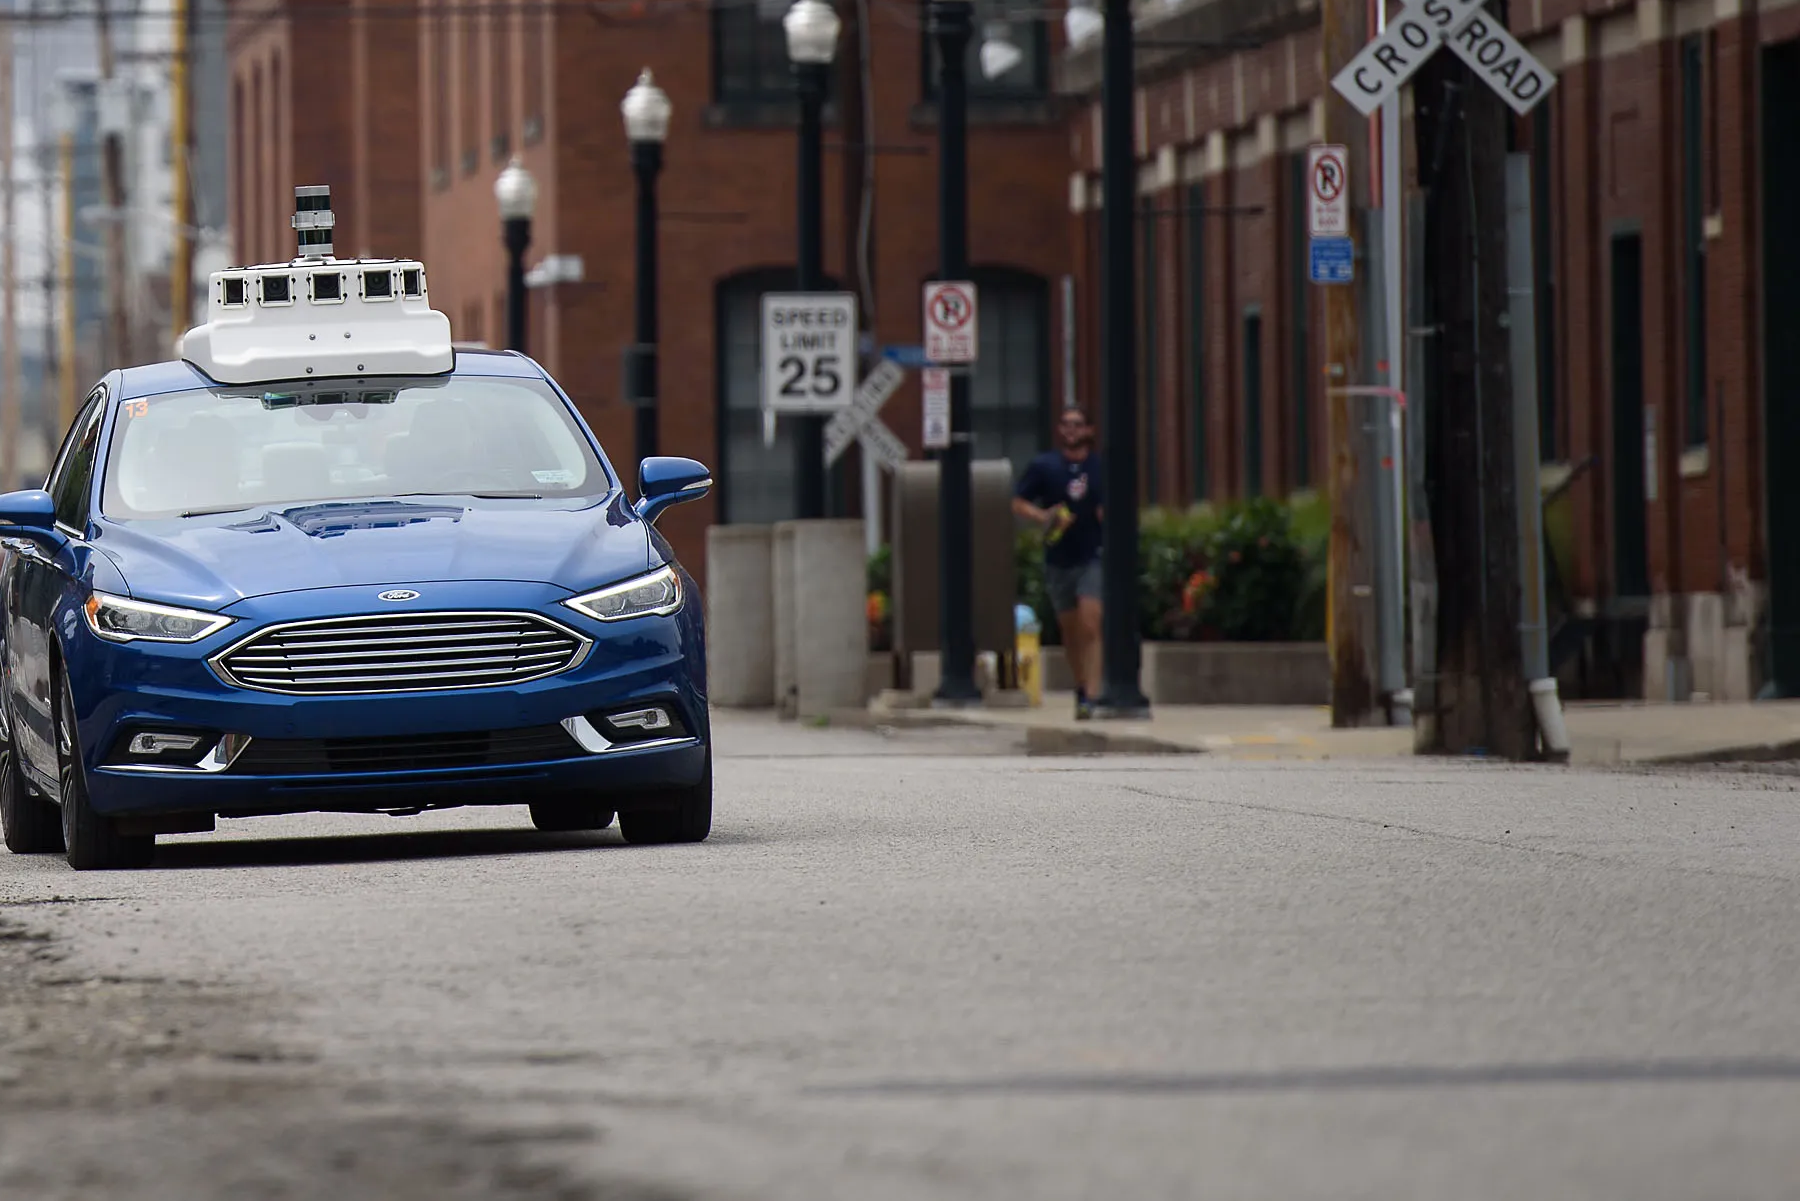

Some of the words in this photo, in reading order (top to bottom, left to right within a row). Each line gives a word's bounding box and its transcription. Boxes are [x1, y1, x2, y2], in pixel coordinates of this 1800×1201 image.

[1454, 15, 1543, 102] ROAD
[771, 306, 848, 330] SPEED
[779, 330, 838, 351] LIMIT
[778, 354, 842, 398] 25
[125, 401, 149, 419] 13
